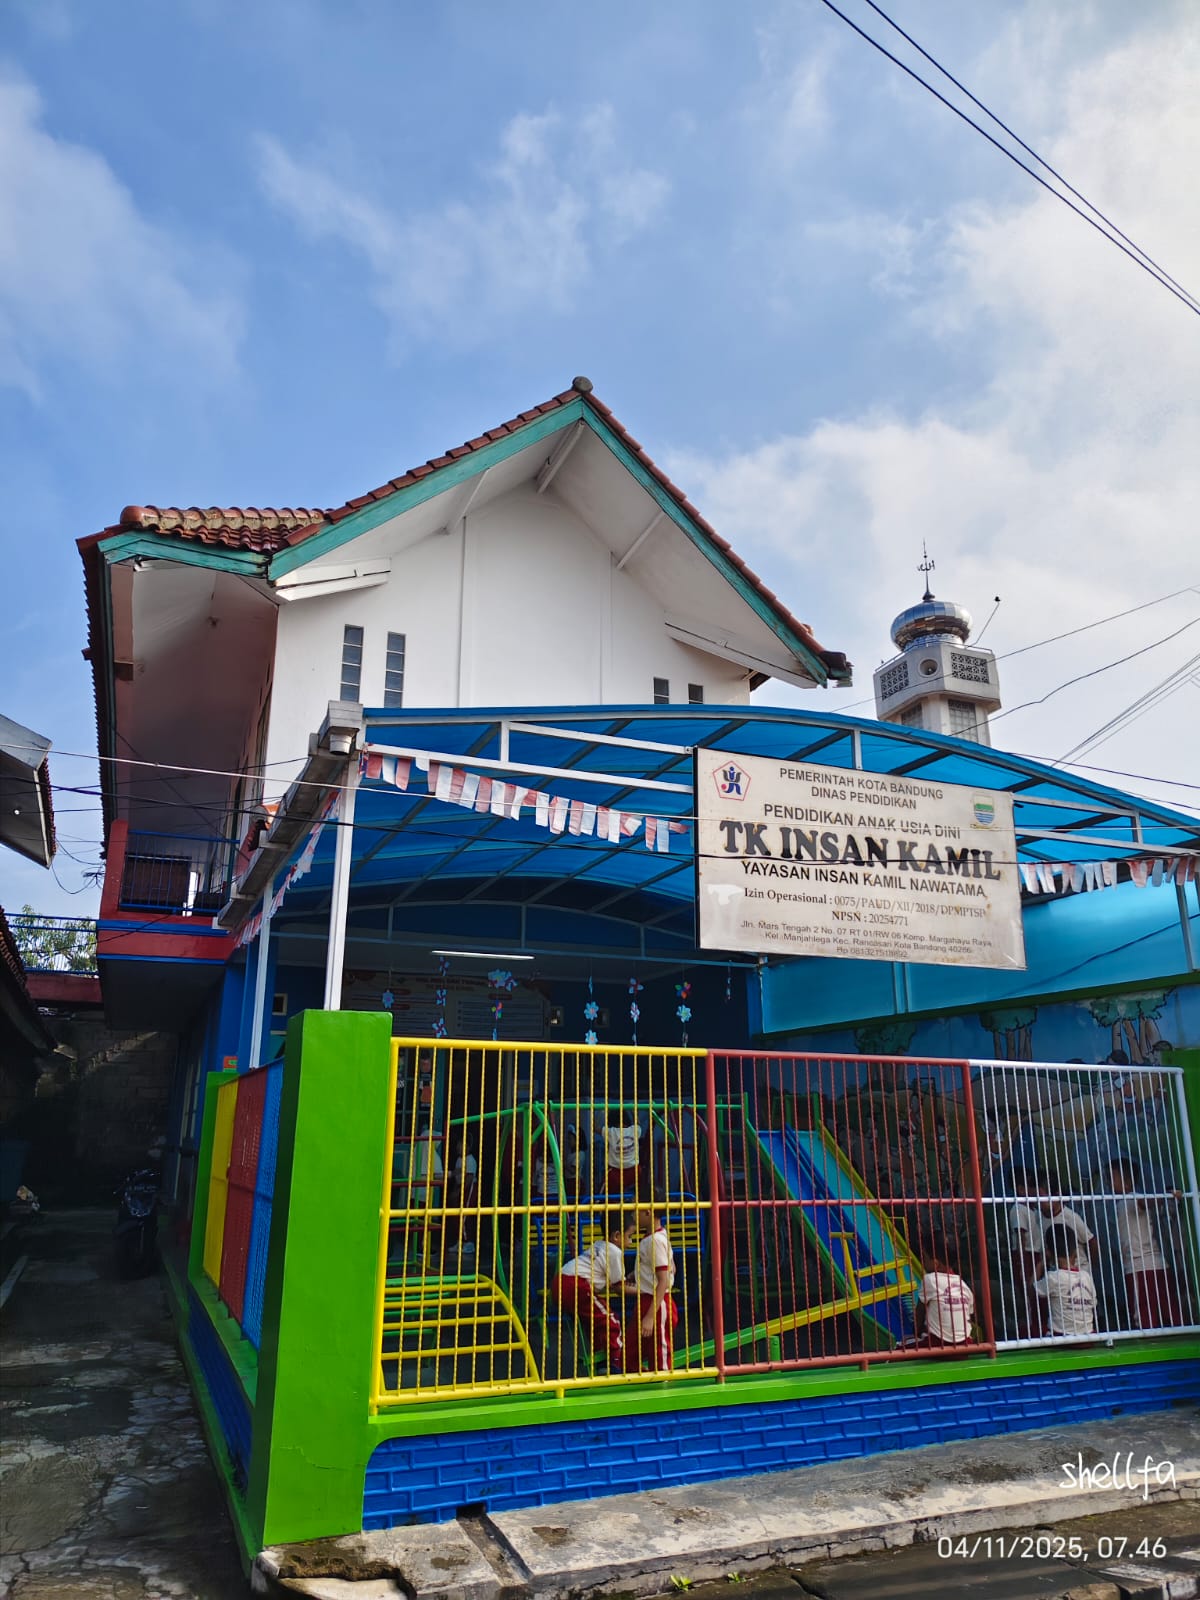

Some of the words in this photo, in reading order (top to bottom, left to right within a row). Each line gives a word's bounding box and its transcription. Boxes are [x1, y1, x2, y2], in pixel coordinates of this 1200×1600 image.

[780, 768, 854, 787] PEMERINTAH
[858, 779, 887, 792] KOTA
[891, 784, 943, 799] BANDUNG
[811, 787, 846, 800] DINAS
[850, 791, 917, 809] PENDIDIKAN
[764, 804, 854, 826] PENDIDIKAN
[858, 815, 897, 831] ANAK
[900, 821, 930, 836] USIA
[935, 825, 961, 839] DINI
[720, 819, 772, 855] TK
[780, 826, 889, 870] INSAN
[898, 841, 1001, 880] KAMIL
[742, 861, 809, 880] YAYASAN
[815, 869, 858, 884] INSAN
[863, 874, 906, 889] KAMIL
[910, 879, 985, 897] NAWATAMA
[744, 888, 764, 899] Izin
[767, 889, 827, 904] Operasional
[832, 911, 861, 922] NPSN
[869, 914, 908, 926] 20254771
[758, 921, 779, 930] Mars
[782, 924, 812, 933] Tengah
[929, 934, 971, 945] Margahayu
[972, 938, 992, 947] Raya
